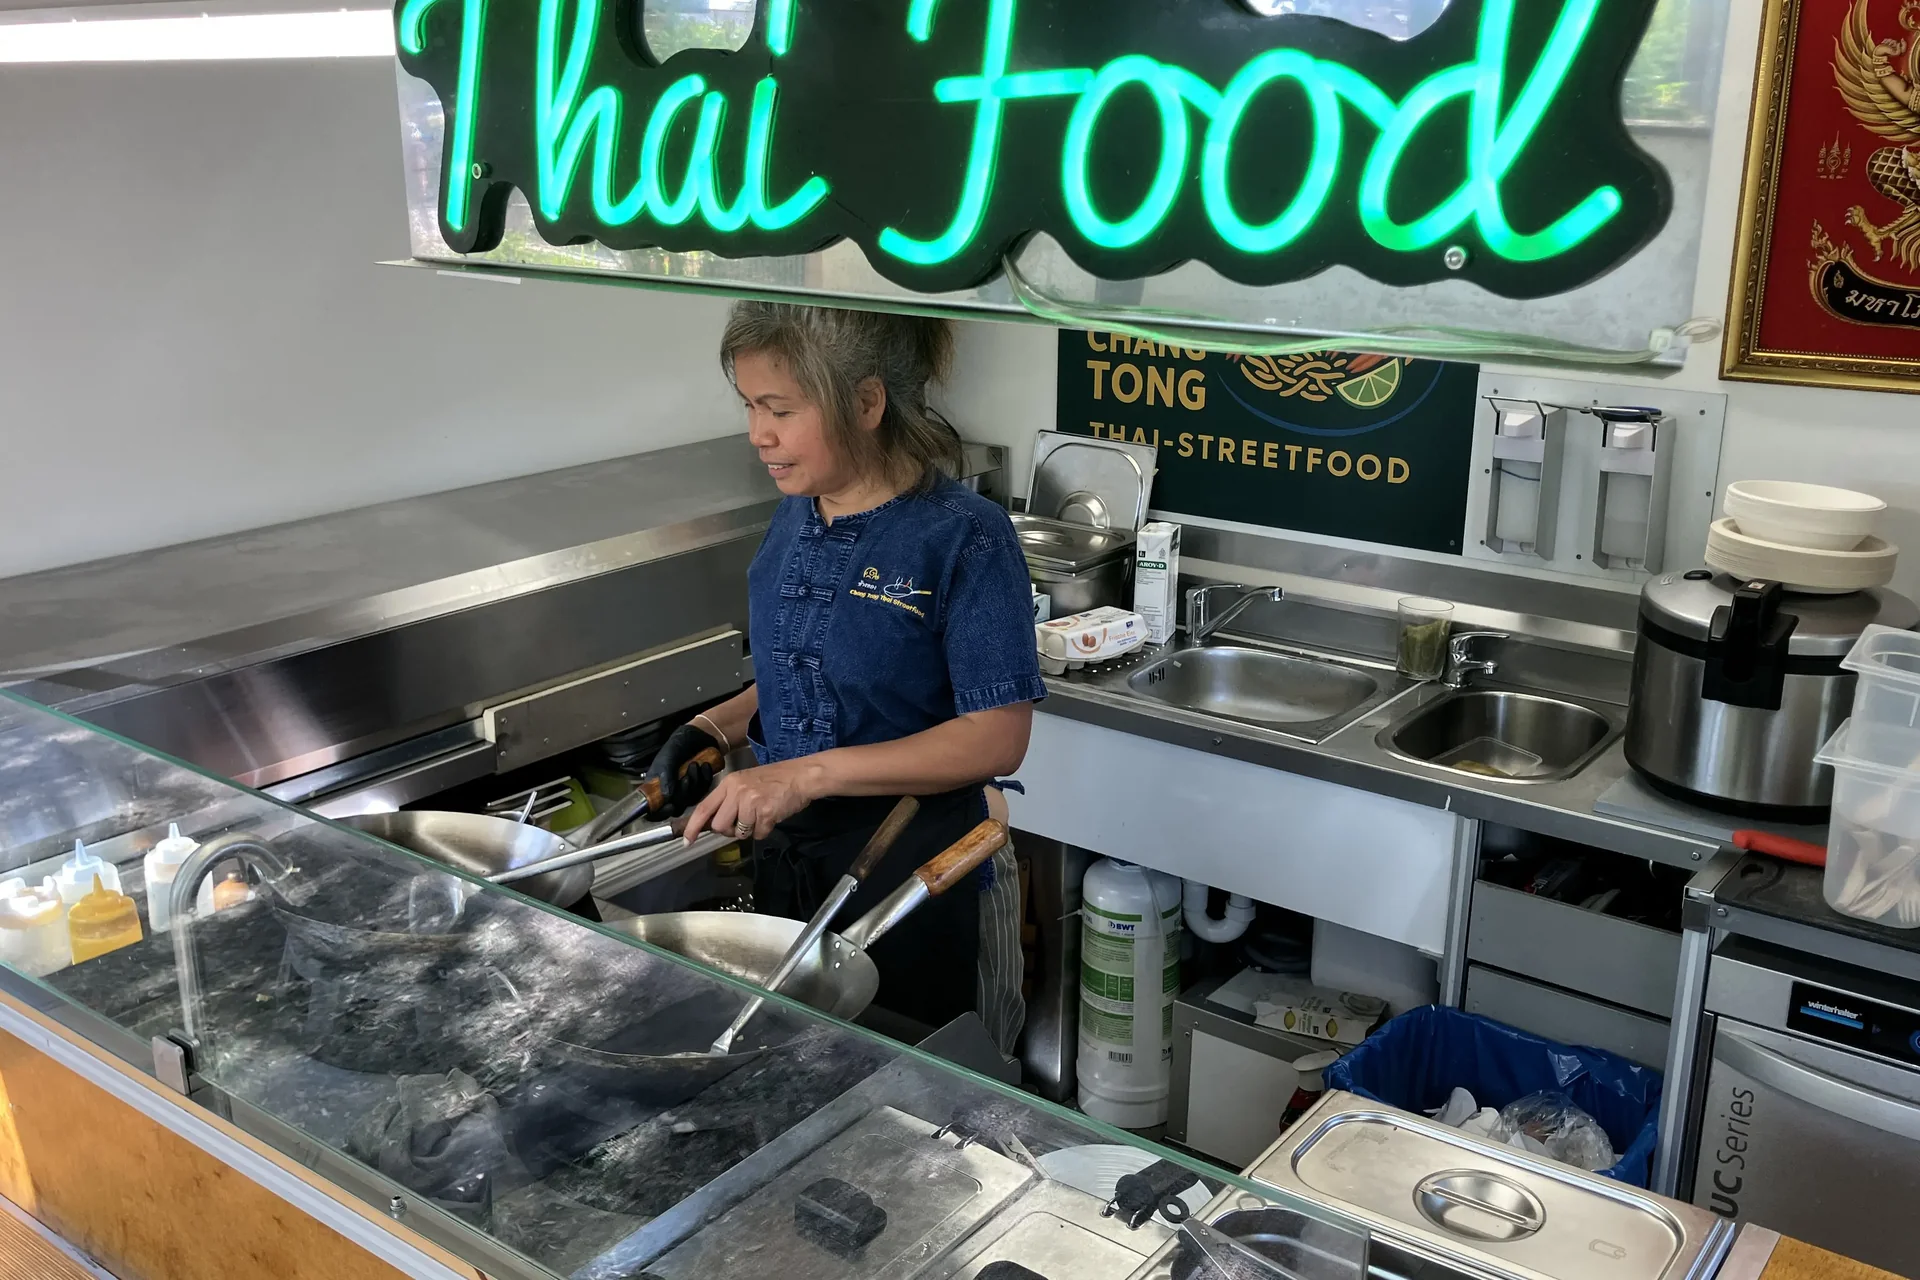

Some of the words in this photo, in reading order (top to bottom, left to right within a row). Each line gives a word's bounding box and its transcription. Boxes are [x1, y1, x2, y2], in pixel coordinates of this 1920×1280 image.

[400, 0, 832, 231] Thai
[878, 0, 1623, 265] Food
[1086, 359, 1206, 411] TONG
[1116, 923, 1135, 931] BWT
[1808, 1001, 1859, 1019] winterhalter
